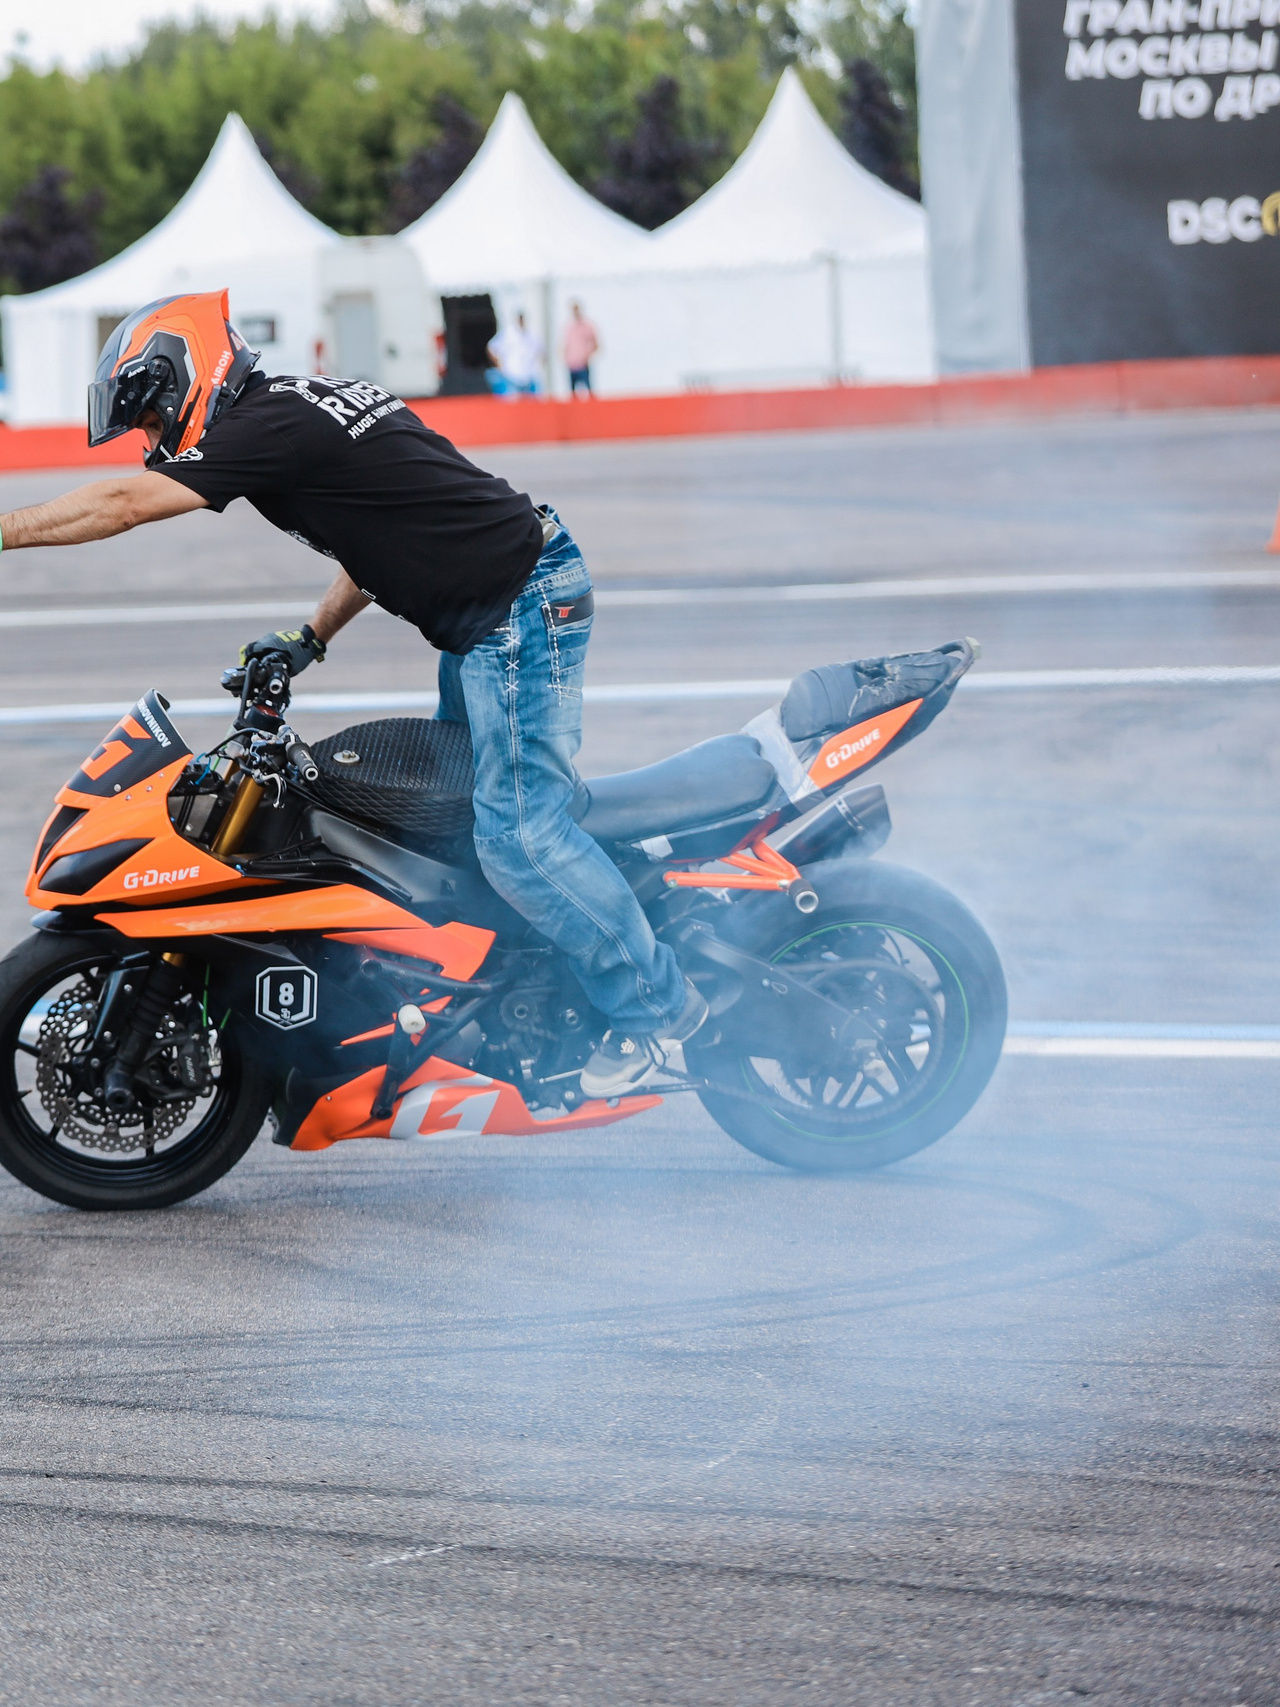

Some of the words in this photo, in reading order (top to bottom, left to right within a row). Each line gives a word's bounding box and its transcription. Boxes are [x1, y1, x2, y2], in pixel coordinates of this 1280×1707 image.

[1065, 30, 1278, 81] МОСКВЫ
[1138, 77, 1213, 121] ПО
[211, 350, 232, 385] AIROH
[347, 413, 377, 440] HUGE
[278, 982, 295, 1006] 8
